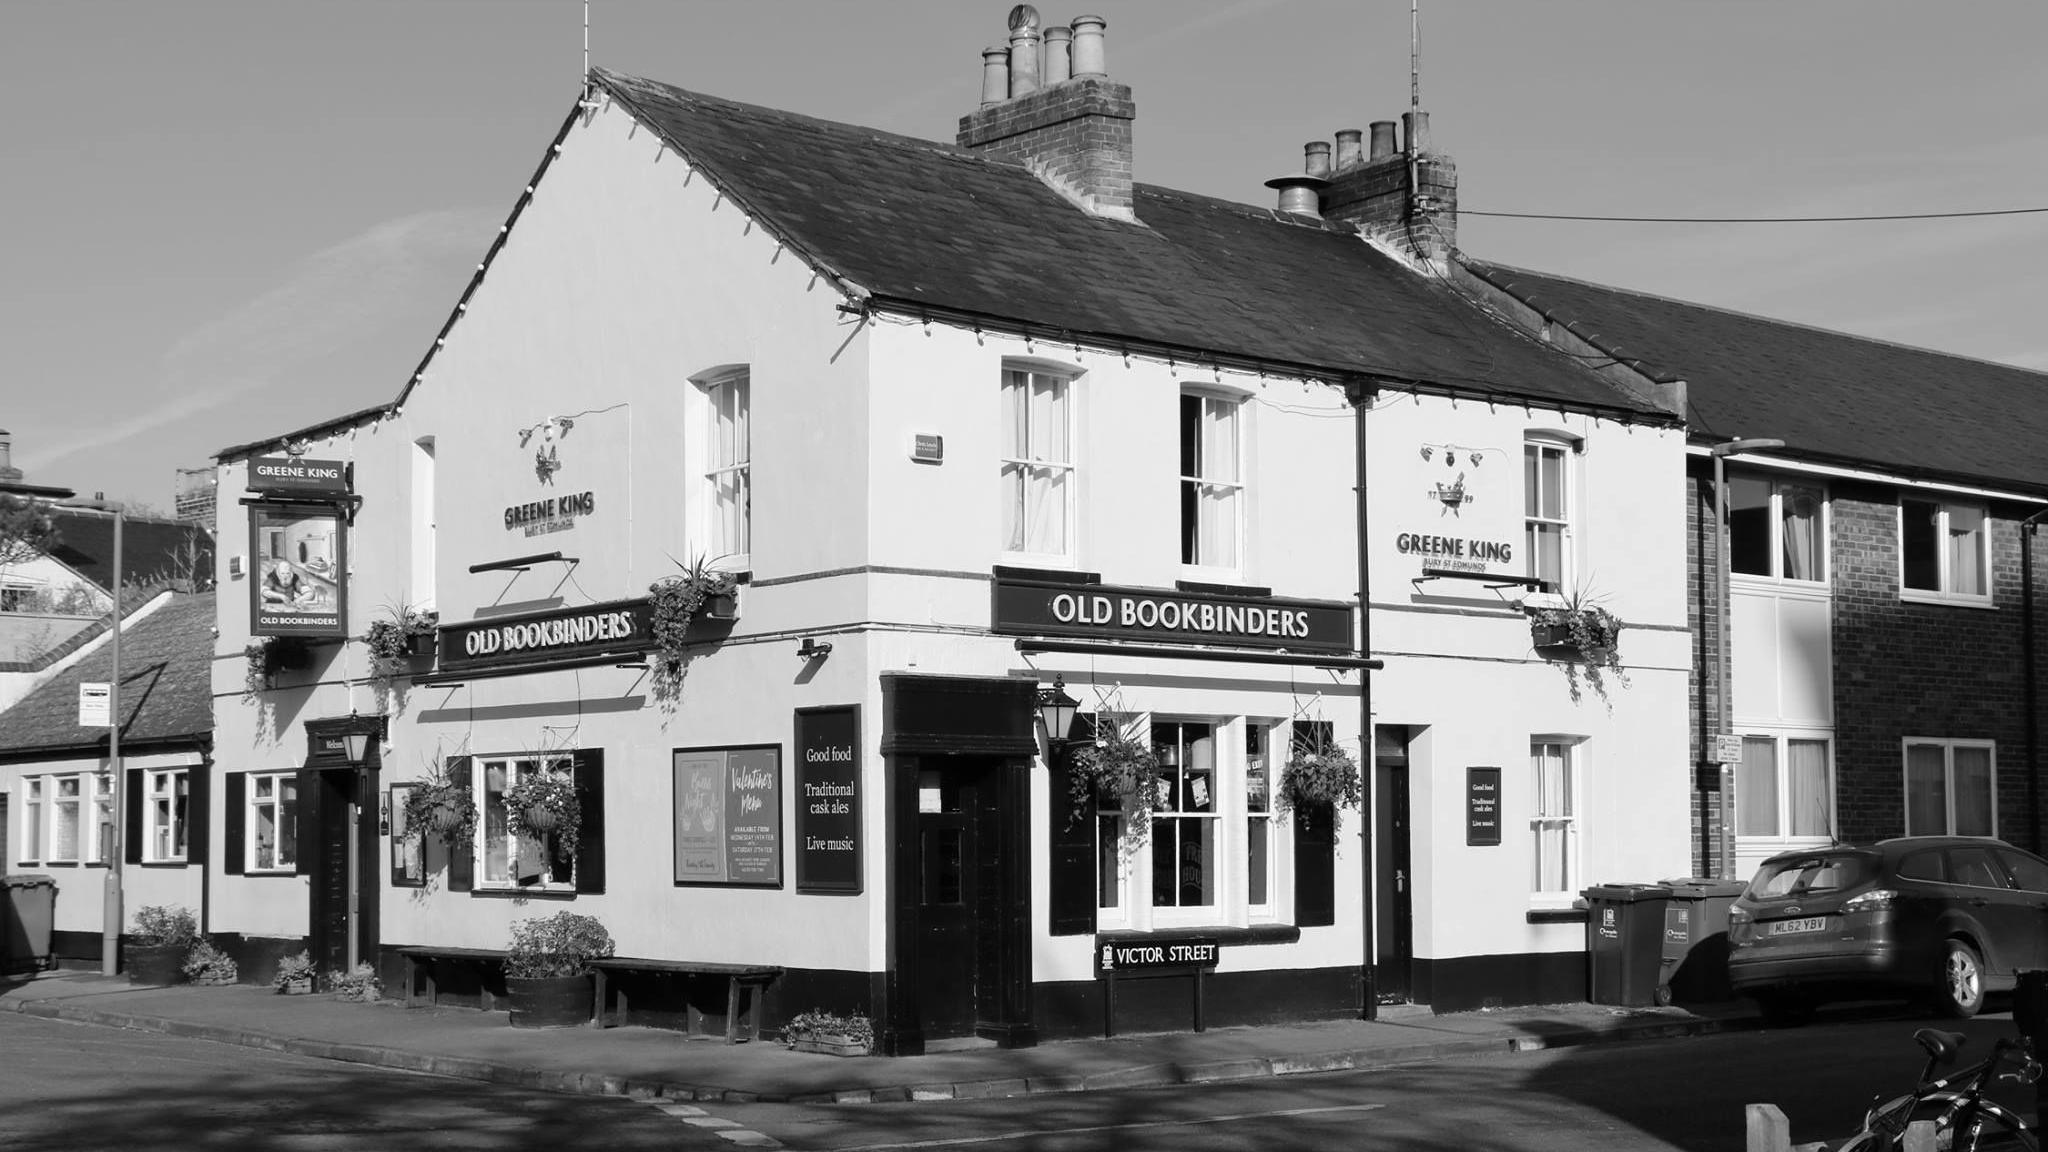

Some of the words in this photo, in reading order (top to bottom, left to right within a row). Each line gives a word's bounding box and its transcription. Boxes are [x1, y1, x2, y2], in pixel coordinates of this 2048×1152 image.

[257, 465, 304, 478] GREENE
[307, 467, 338, 479] KING
[504, 499, 554, 530] GREENE
[558, 491, 594, 516] KING
[1397, 533, 1464, 556] GREENE
[1469, 540, 1511, 562] KING
[1453, 561, 1486, 572] EDMUNDS
[260, 616, 278, 625] OLD
[279, 617, 338, 626] BOOKBINDERS
[1052, 593, 1113, 625] OLD
[1120, 598, 1309, 639] BOOKBINDERS
[466, 628, 500, 656] OLD
[503, 611, 631, 651] BOOKBINDERS
[806, 748, 830, 762] Good
[831, 746, 852, 761] food
[732, 765, 773, 792] Valentine's
[805, 781, 854, 797] Traditional
[741, 793, 763, 816] Menu
[810, 799, 829, 814] cask
[831, 799, 849, 814] ales
[806, 836, 826, 850] Live
[827, 835, 854, 851] music
[1803, 918, 1824, 930] YBV
[1117, 947, 1164, 964] VICTOR
[1169, 944, 1215, 961] STREET
